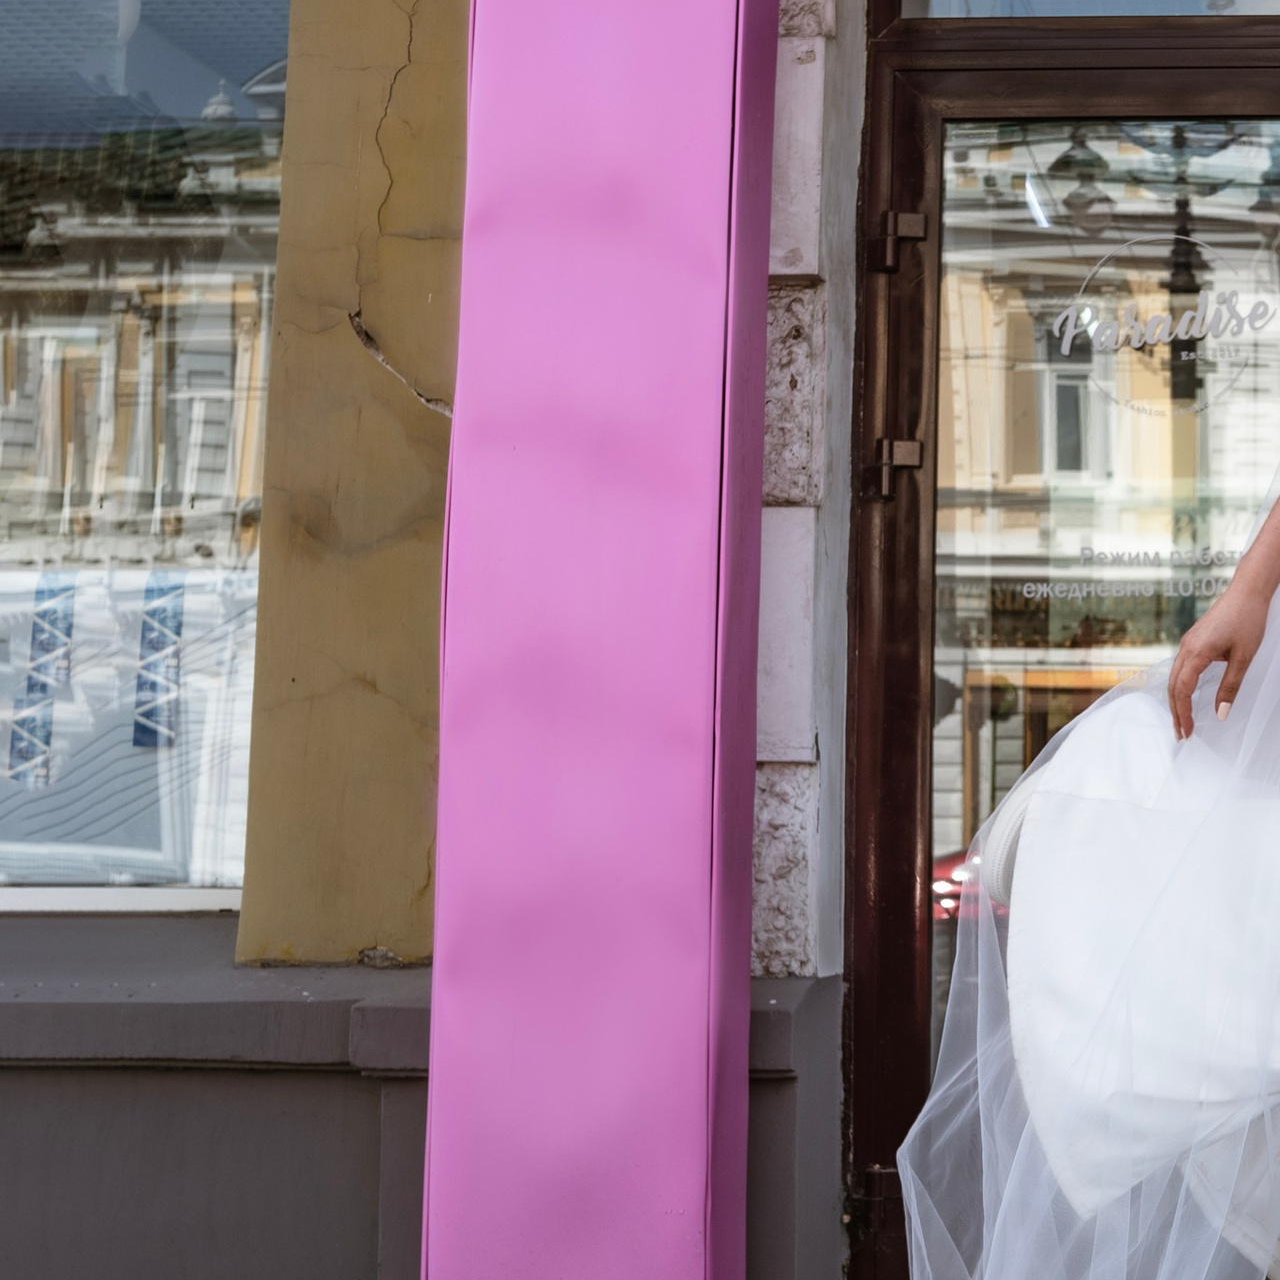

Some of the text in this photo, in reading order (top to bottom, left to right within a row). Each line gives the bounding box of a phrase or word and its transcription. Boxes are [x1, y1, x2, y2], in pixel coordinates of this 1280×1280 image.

[1052, 289, 1277, 356] Paradise
[1080, 546, 1245, 571] Режим работ
[1022, 580, 1154, 603] ежедневно
